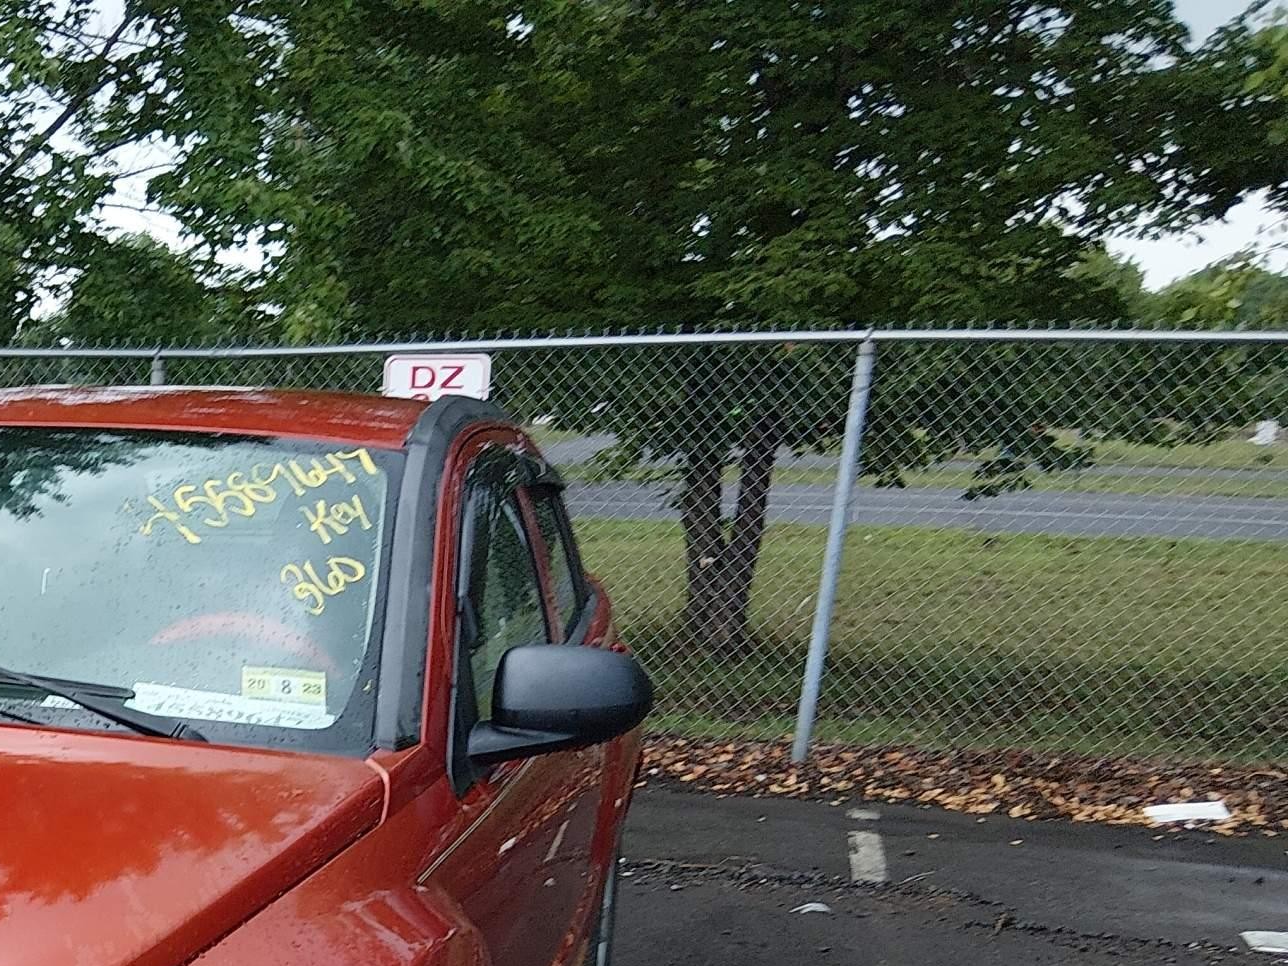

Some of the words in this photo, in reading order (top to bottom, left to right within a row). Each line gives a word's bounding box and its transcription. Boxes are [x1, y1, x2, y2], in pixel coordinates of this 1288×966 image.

[410, 365, 464, 389] DZ
[280, 679, 293, 695] 8
[302, 682, 322, 695] 23
